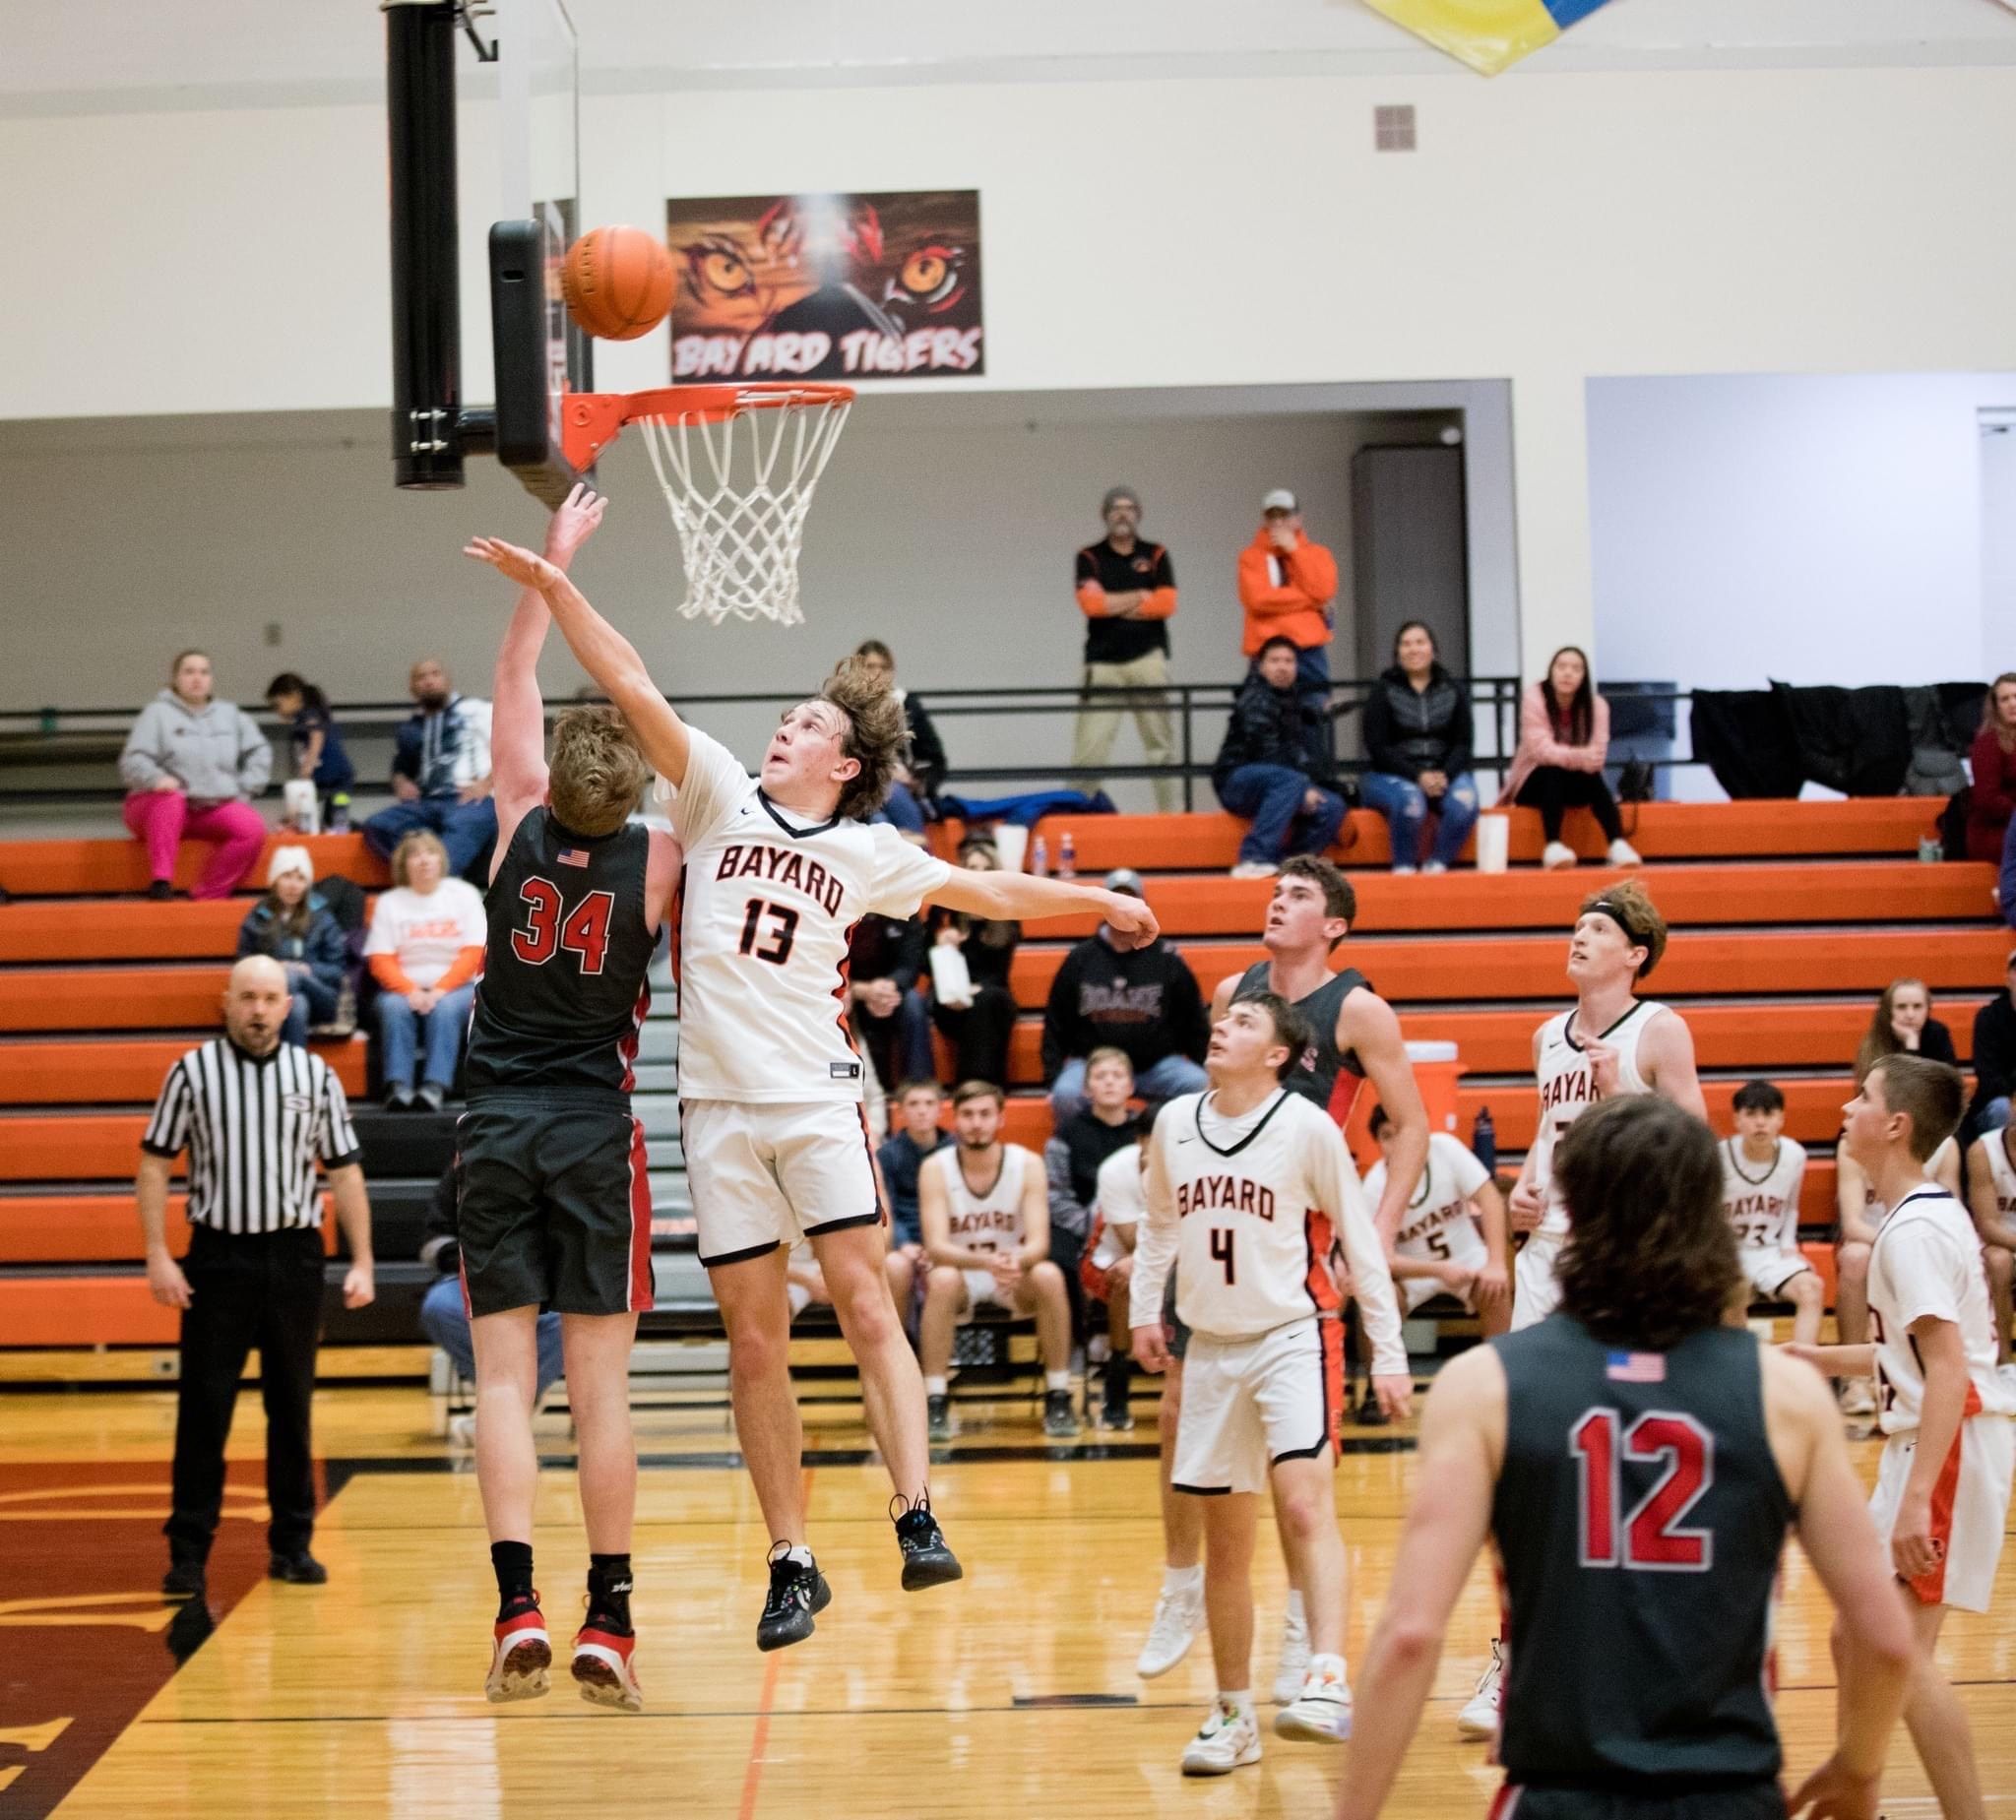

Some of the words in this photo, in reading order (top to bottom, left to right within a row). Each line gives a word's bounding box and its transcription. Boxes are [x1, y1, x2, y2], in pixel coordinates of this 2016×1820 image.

[673, 332, 832, 377] BAYARD
[839, 326, 982, 373] TIGERS
[716, 844, 845, 919] BAYARD
[510, 874, 616, 975] 34
[738, 897, 800, 968] 13
[1543, 1070, 1602, 1112] BAYAR
[1177, 1174, 1275, 1223] BAYARD
[1396, 1200, 1464, 1244] BAYARD
[1209, 1227, 1235, 1287] 4
[1426, 1230, 1451, 1260] 5
[1568, 1406, 1714, 1572] 12
